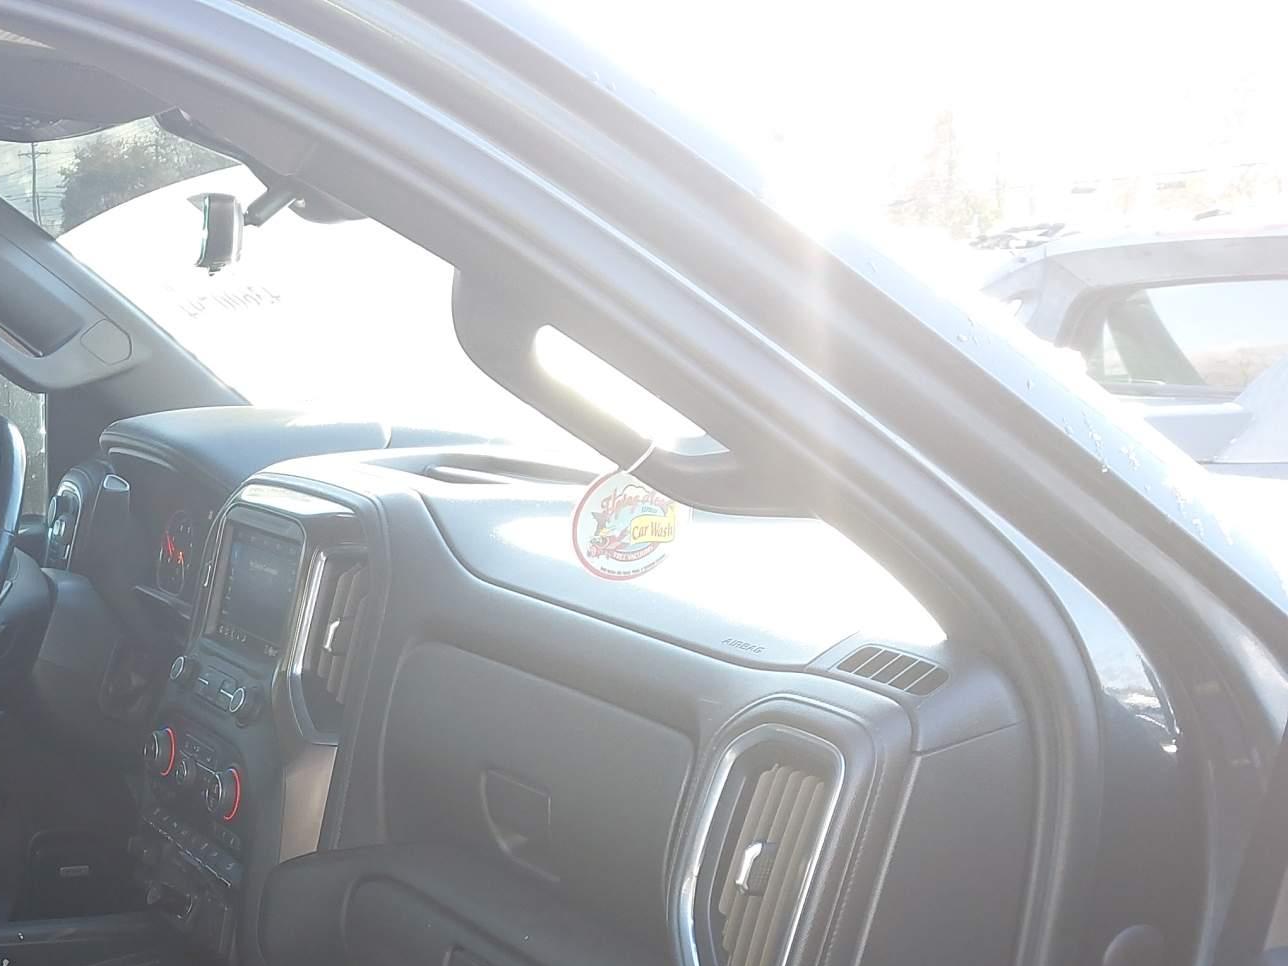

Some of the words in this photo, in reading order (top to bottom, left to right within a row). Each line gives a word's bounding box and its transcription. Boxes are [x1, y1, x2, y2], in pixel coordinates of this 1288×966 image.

[631, 524, 649, 541] Car
[649, 520, 674, 538] Wash
[721, 637, 766, 654] AIRBAG
